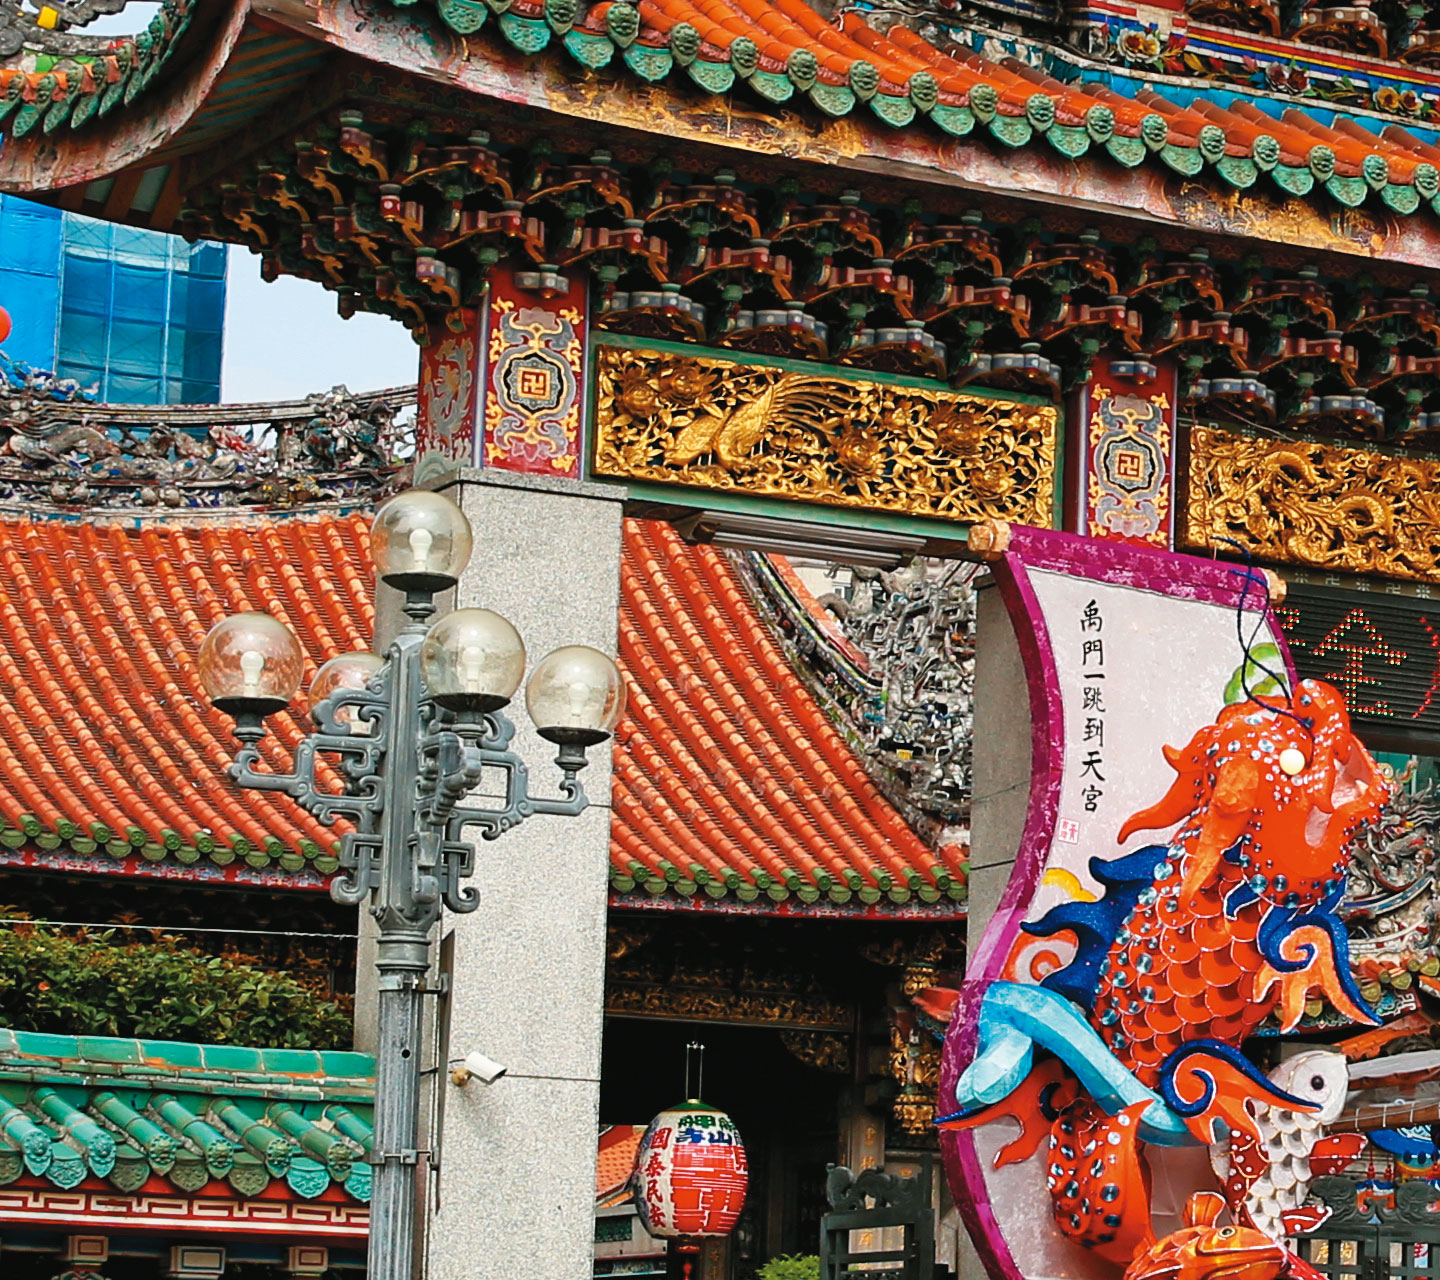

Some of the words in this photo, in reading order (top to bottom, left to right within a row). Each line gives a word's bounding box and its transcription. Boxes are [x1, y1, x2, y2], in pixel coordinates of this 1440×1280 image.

[1080, 599, 1106, 813] 禹門一跳到天宮
